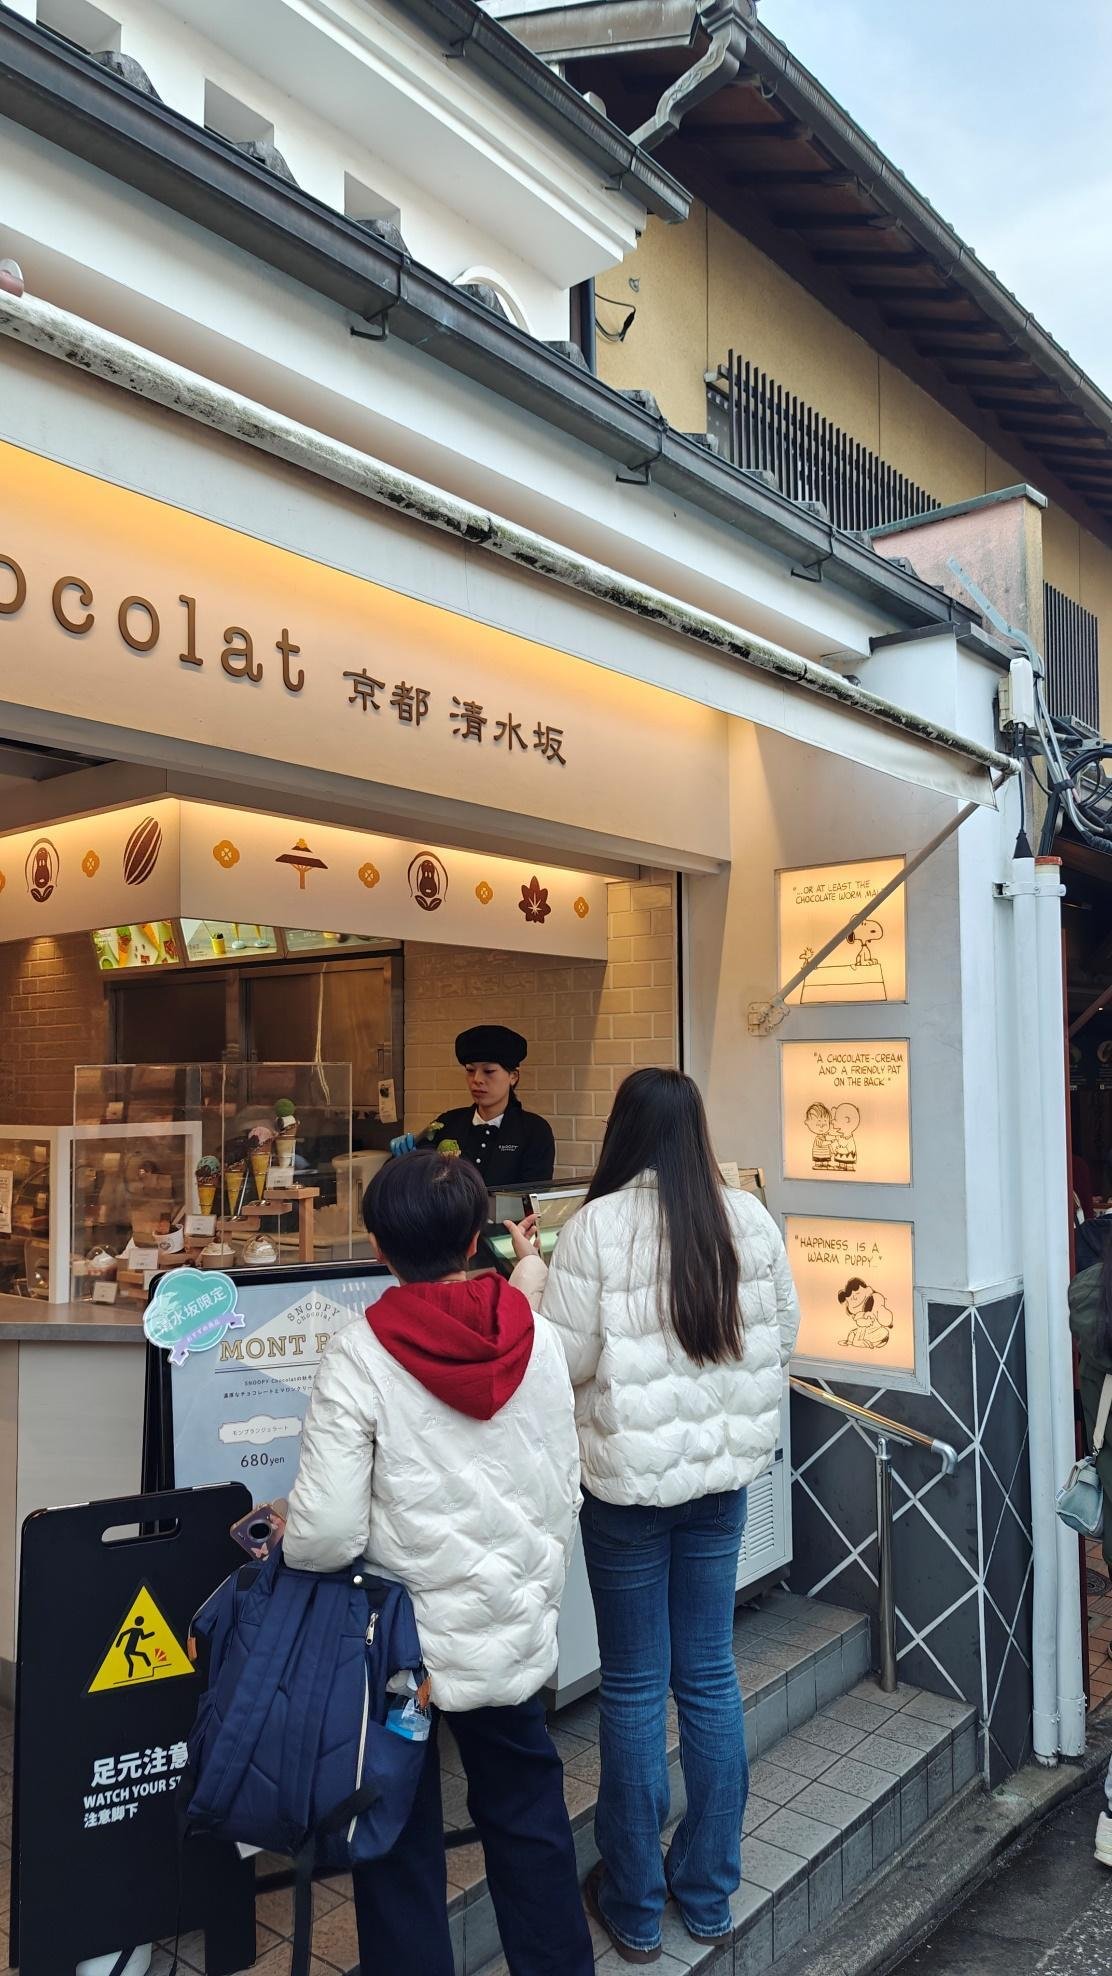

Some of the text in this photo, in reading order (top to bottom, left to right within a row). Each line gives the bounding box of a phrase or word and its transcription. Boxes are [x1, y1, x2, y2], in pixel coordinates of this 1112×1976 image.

[343, 668, 567, 766] 京都 清水坂
[816, 884, 826, 893] AT
[828, 882, 852, 892] LEAST
[856, 880, 870, 889] THE
[796, 893, 836, 904] CHOCOLATE
[839, 891, 861, 900] WORM
[819, 1065, 901, 1076] AND A FRIENDLY PAT
[834, 1077, 845, 1086] ON
[847, 1077, 861, 1086] THE
[808, 1252, 839, 1264] WARM
[857, 1242, 866, 1252] IS
[872, 1243, 879, 1253] A
[157, 1286, 227, 1336] 清水坂限定
[288, 1301, 340, 1322] SNOOPY
[220, 1335, 306, 1361] MONT
[91, 1741, 189, 1788] 足元注意
[83, 1787, 129, 1809] WATCH
[132, 1779, 166, 1798] YOUR
[84, 1802, 138, 1828] 注意脚下
